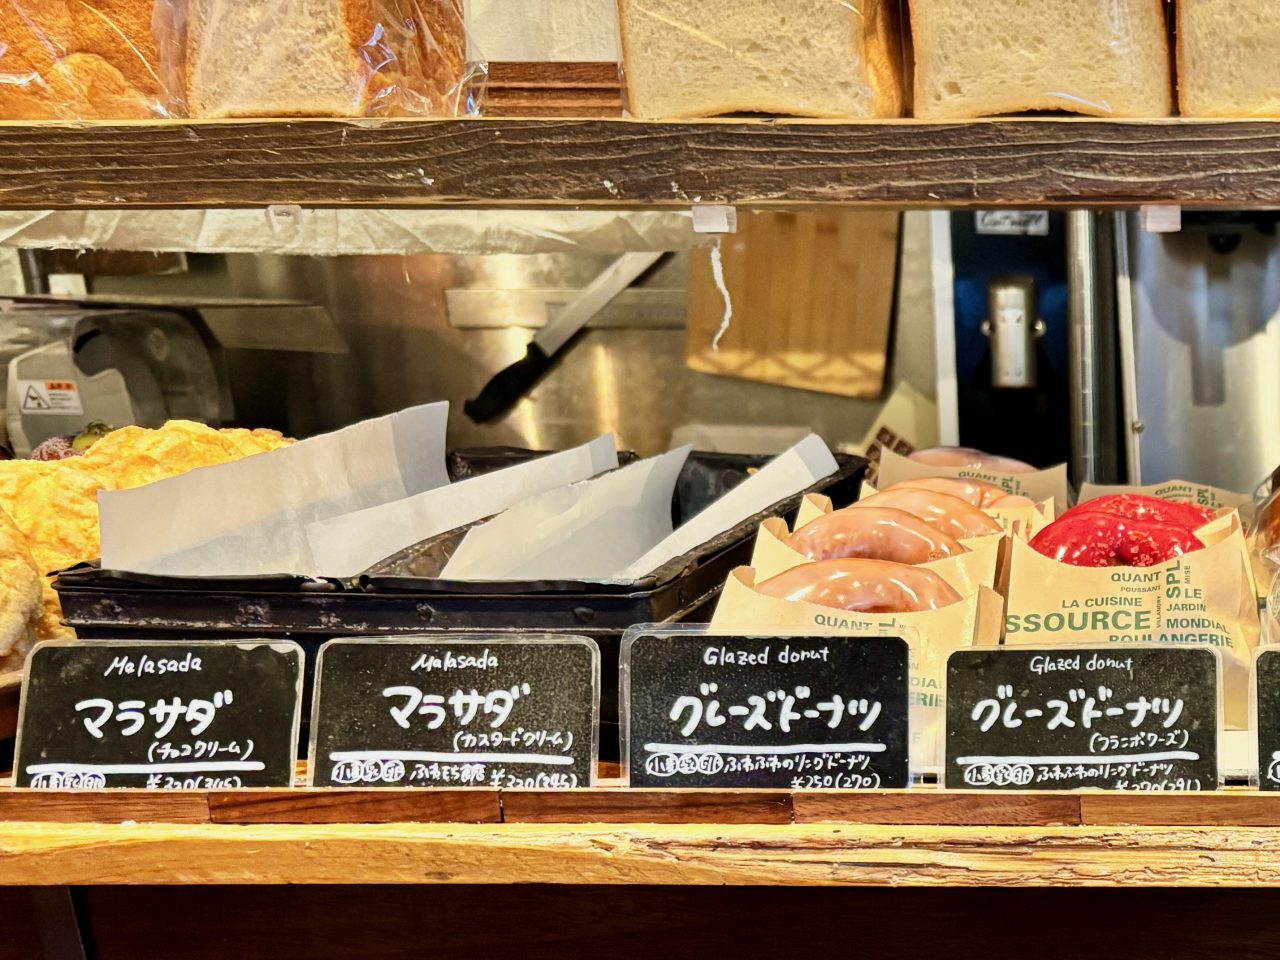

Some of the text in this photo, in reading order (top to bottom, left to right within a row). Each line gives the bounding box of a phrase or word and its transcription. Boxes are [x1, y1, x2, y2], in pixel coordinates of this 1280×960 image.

[1111, 571, 1162, 583] QUANT
[1120, 585, 1162, 593] POUSSANT
[1184, 588, 1203, 599] LE
[1062, 596, 1143, 609] LA CUISINE
[1166, 603, 1207, 612] JARDIN
[814, 614, 873, 631] QUANT
[1166, 618, 1230, 635] MONDIAL
[1109, 633, 1235, 648] BOULANGERIE
[411, 648, 499, 672] Malasada
[703, 645, 830, 666] Glazed donut
[1030, 653, 1133, 675] Glazed donut
[75, 689, 233, 739] マラサダ
[382, 682, 531, 729] マラサダ
[669, 682, 882, 737] グレーズドーナツ
[971, 684, 1184, 732] グレーズドーナツ
[453, 728, 573, 751] (カスタードクリーム)
[1089, 729, 1189, 753] (フランボワーズ)
